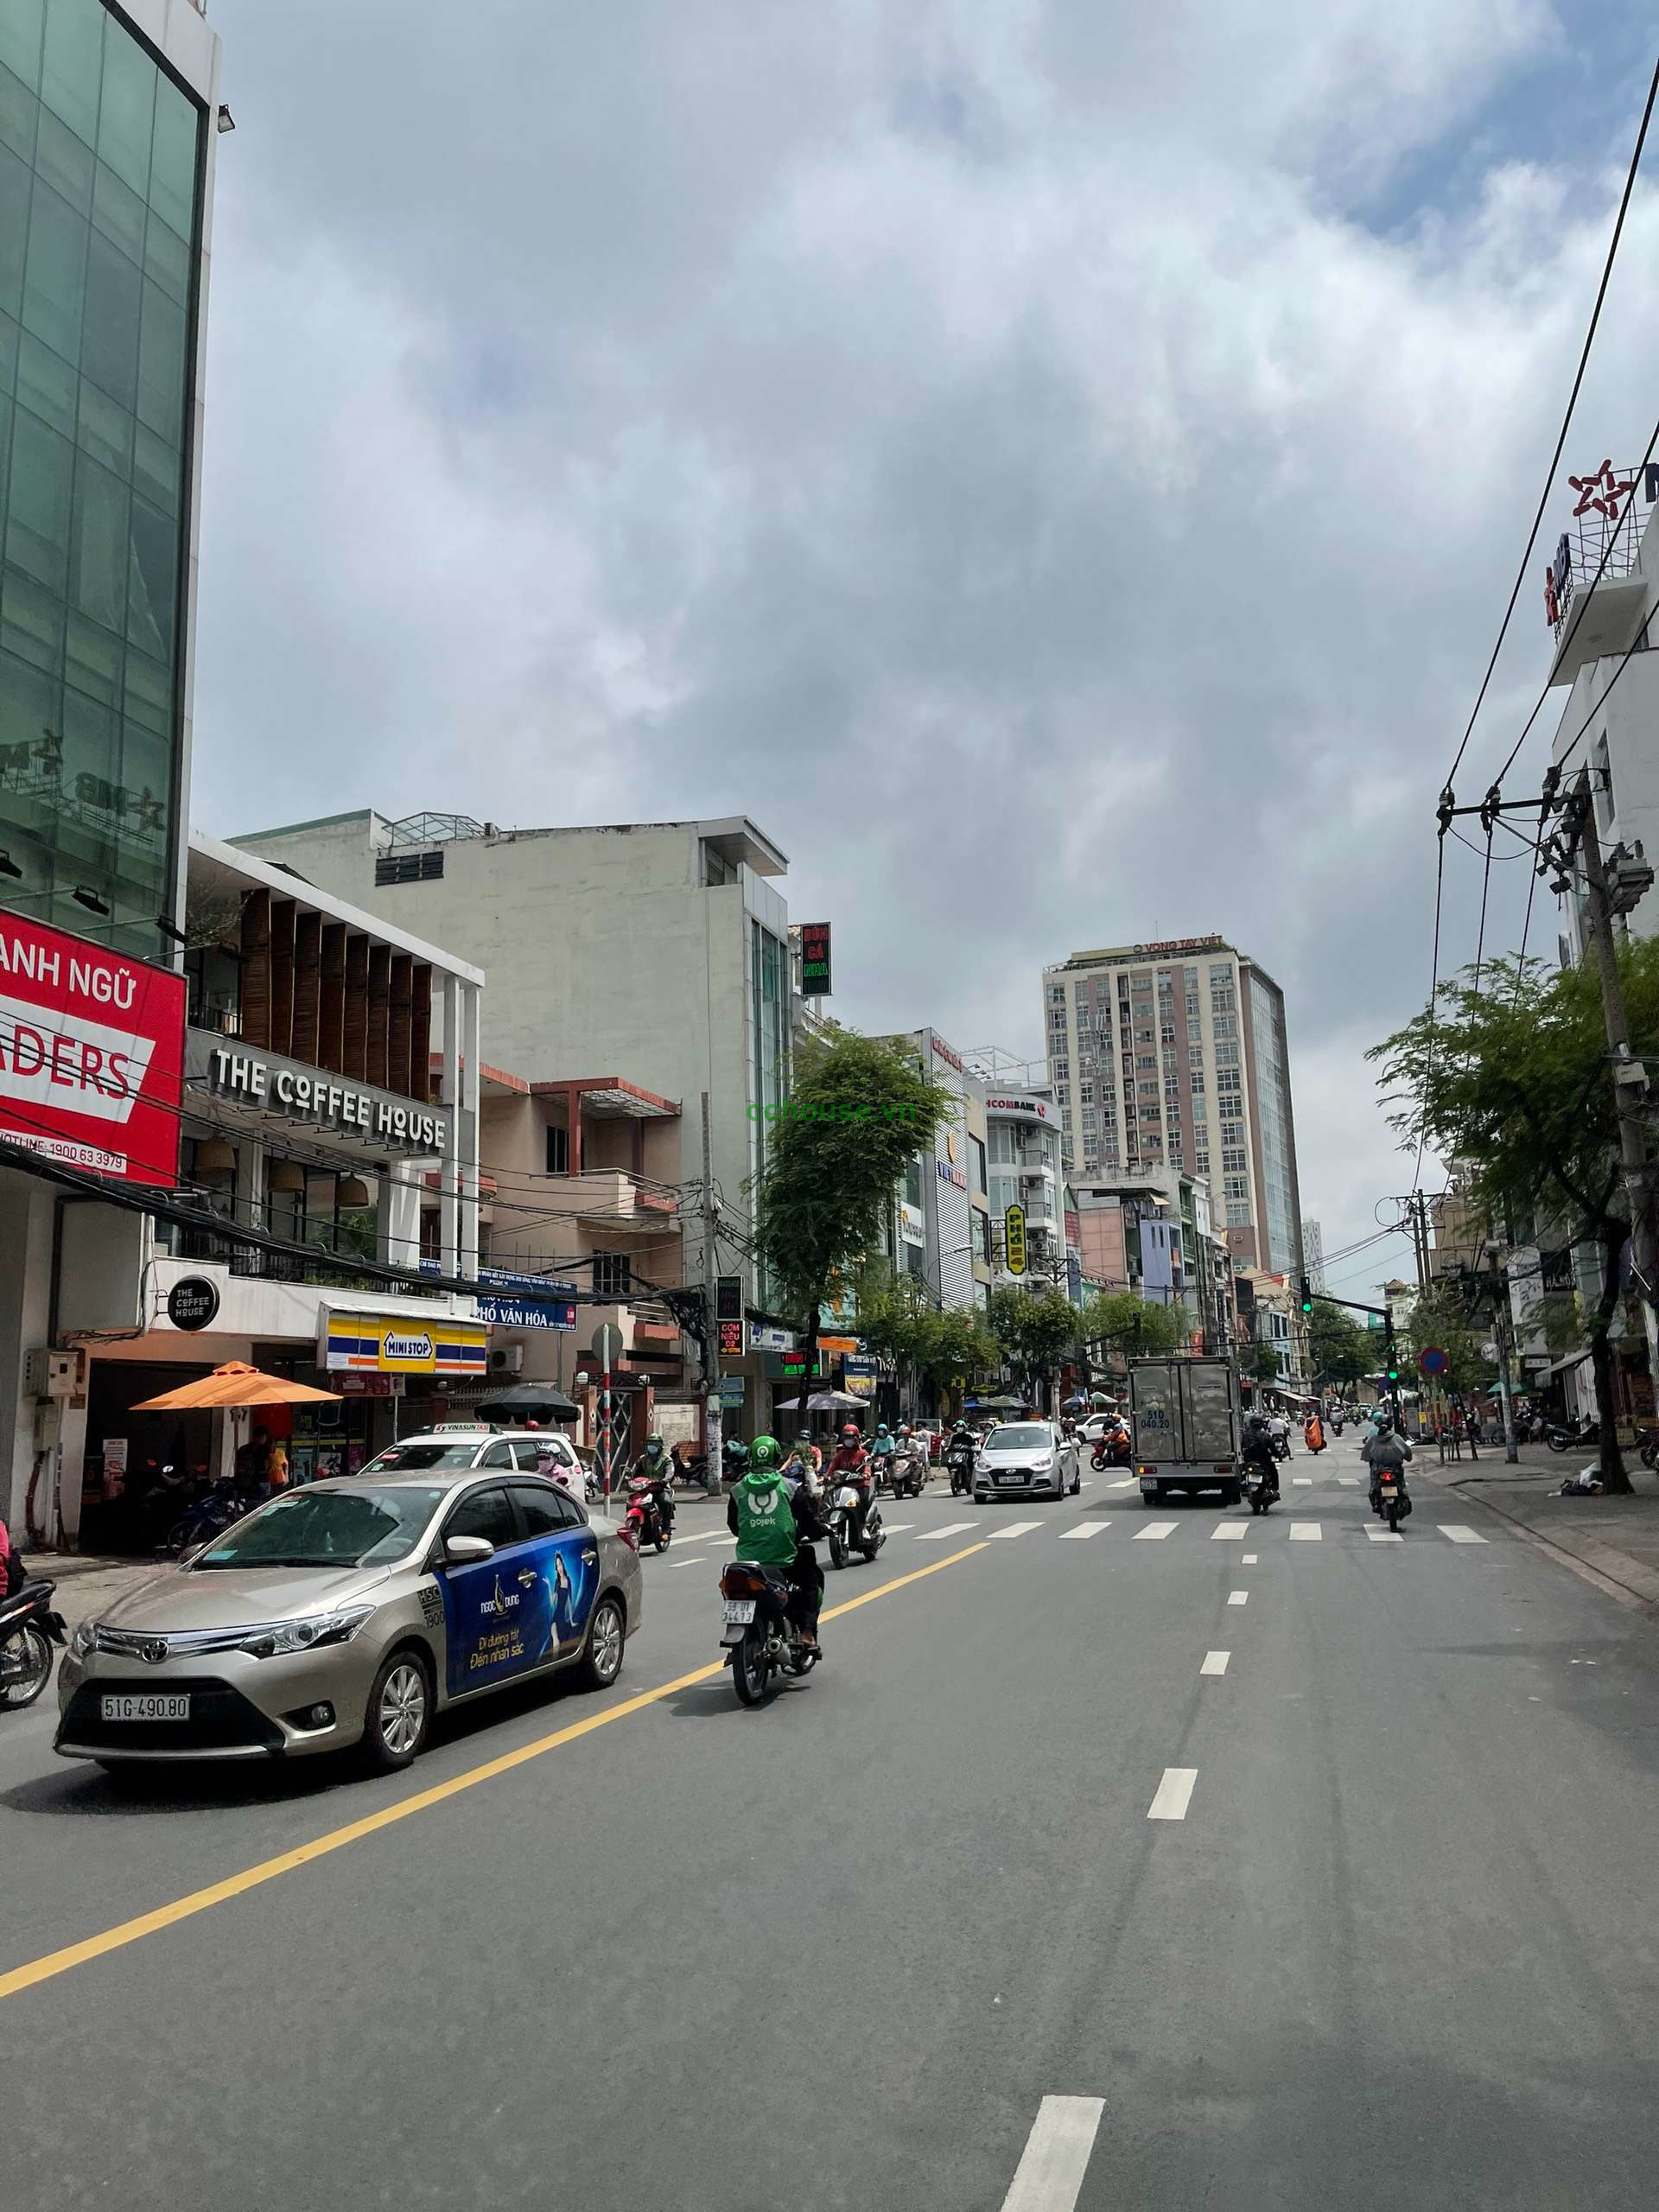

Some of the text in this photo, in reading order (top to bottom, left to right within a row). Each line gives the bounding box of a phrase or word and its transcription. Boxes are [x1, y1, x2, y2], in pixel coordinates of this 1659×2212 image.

[69, 958, 137, 1009] NGỮ
[0, 1024, 129, 1100] DERS
[217, 1049, 446, 1148] THE COFFEE HOUSE
[50, 1143, 77, 1160] 1900
[79, 1149, 93, 1163] 63
[96, 1153, 122, 1168] 3979
[175, 1297, 210, 1307] COFFEE
[176, 1288, 194, 1298] THE
[175, 1307, 204, 1318] HOUSE
[500, 1307, 522, 1324] VĂN
[525, 1310, 547, 1326] HÓA
[1147, 1410, 1164, 1419] 51D
[749, 1516, 776, 1528] gojek
[105, 1697, 187, 1717] 51G-490.80
